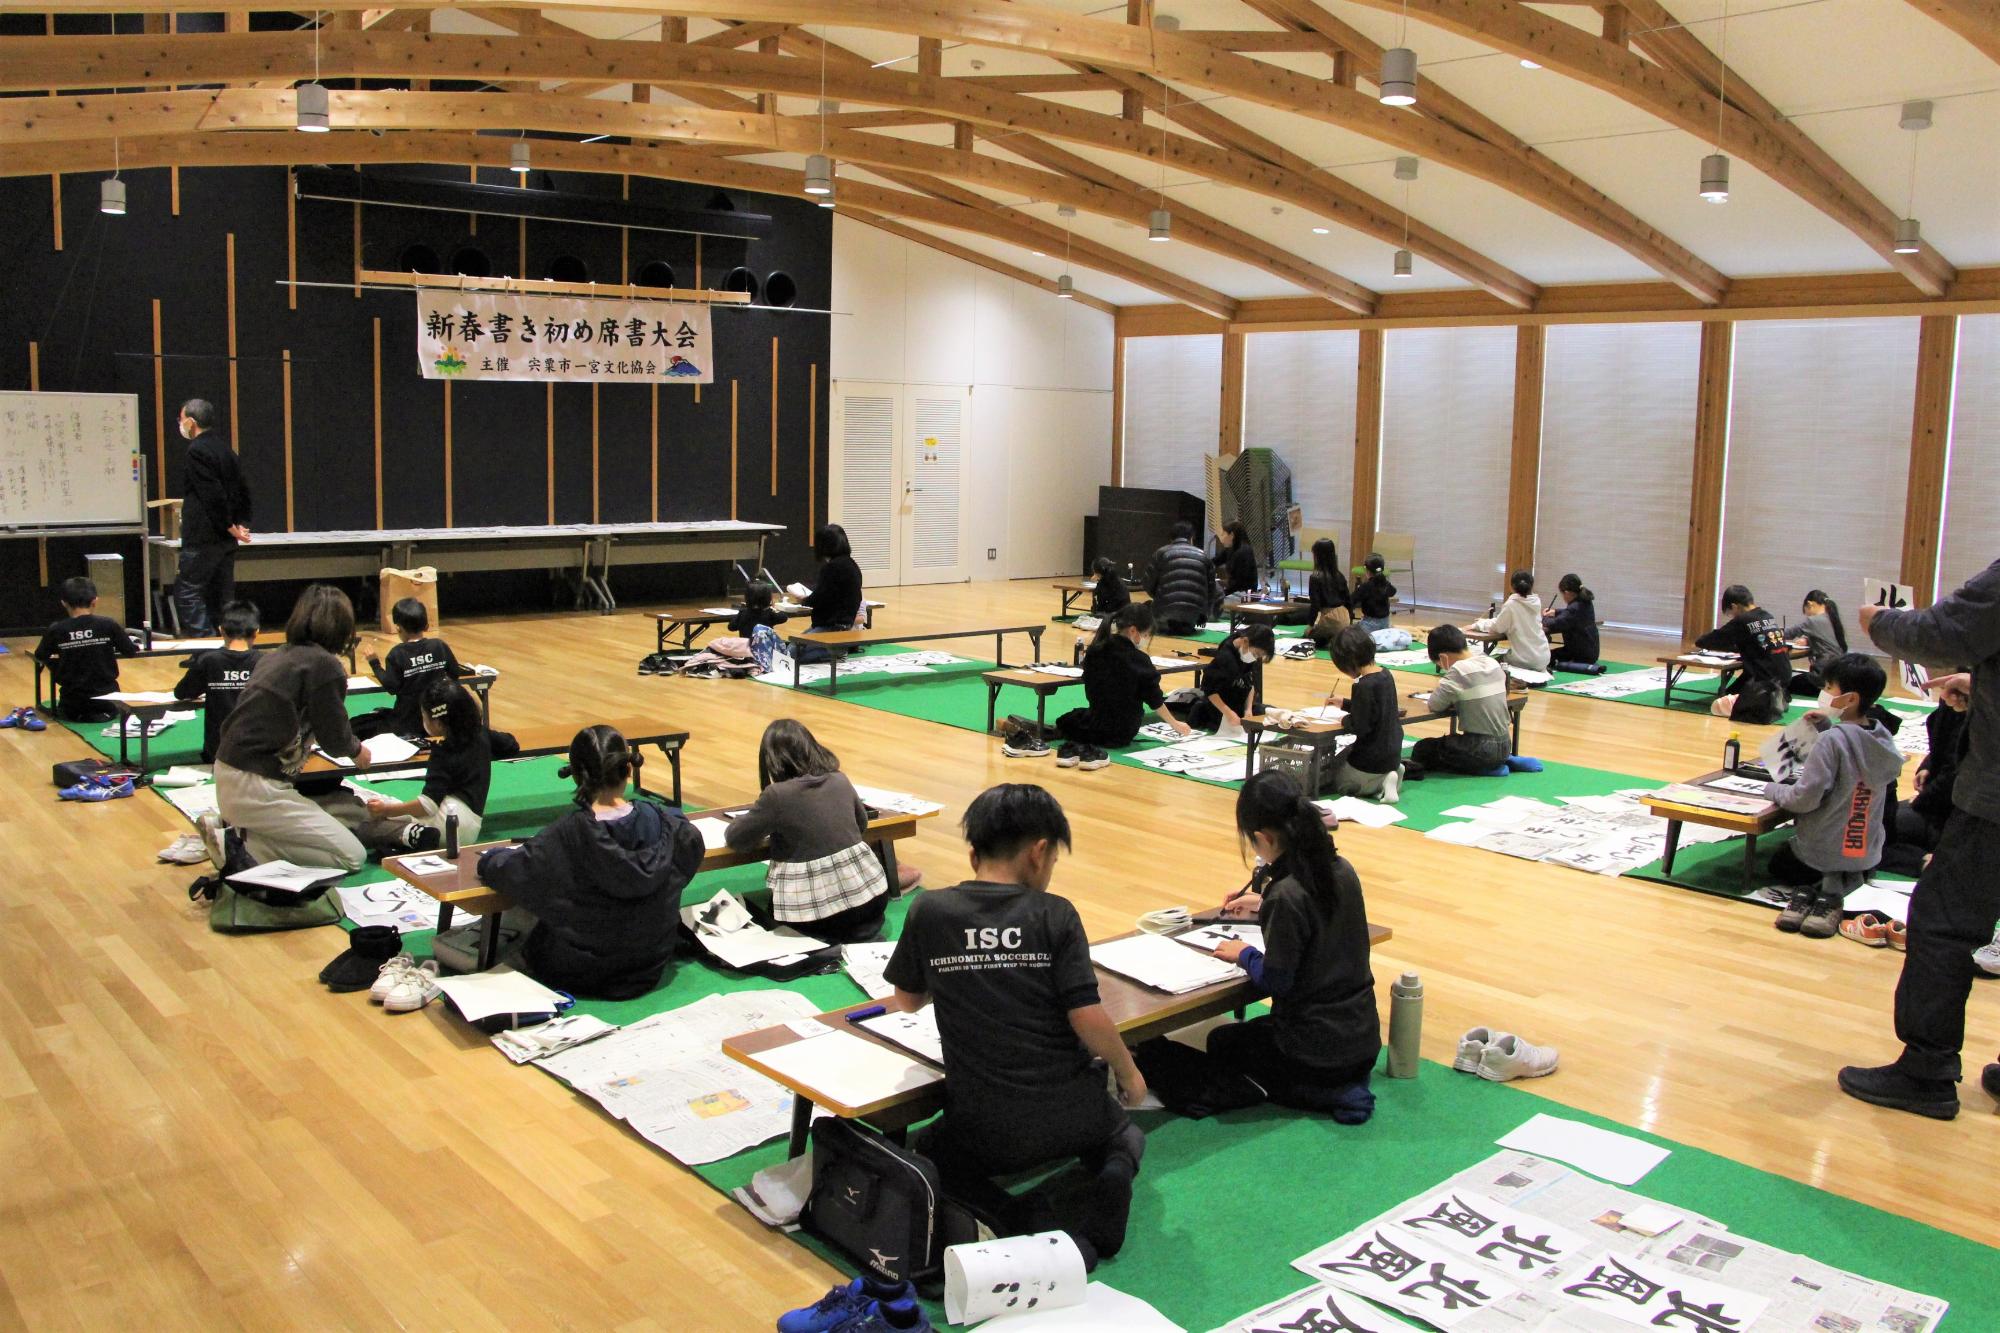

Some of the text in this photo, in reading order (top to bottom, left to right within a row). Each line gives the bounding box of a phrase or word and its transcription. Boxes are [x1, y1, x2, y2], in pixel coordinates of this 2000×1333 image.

[426, 309, 699, 349] 新春書き初め席書大会
[480, 357, 510, 373] 主催
[69, 629, 93, 640] ISC
[409, 653, 434, 667] ISC
[224, 670, 250, 681] ISC
[1845, 787, 1872, 850] ARMOUR
[964, 927, 1022, 950] ISC
[930, 953, 991, 967] ICHINOMIYA
[993, 952, 1036, 961] SOCCER
[869, 1259, 899, 1281] MIZUNO
